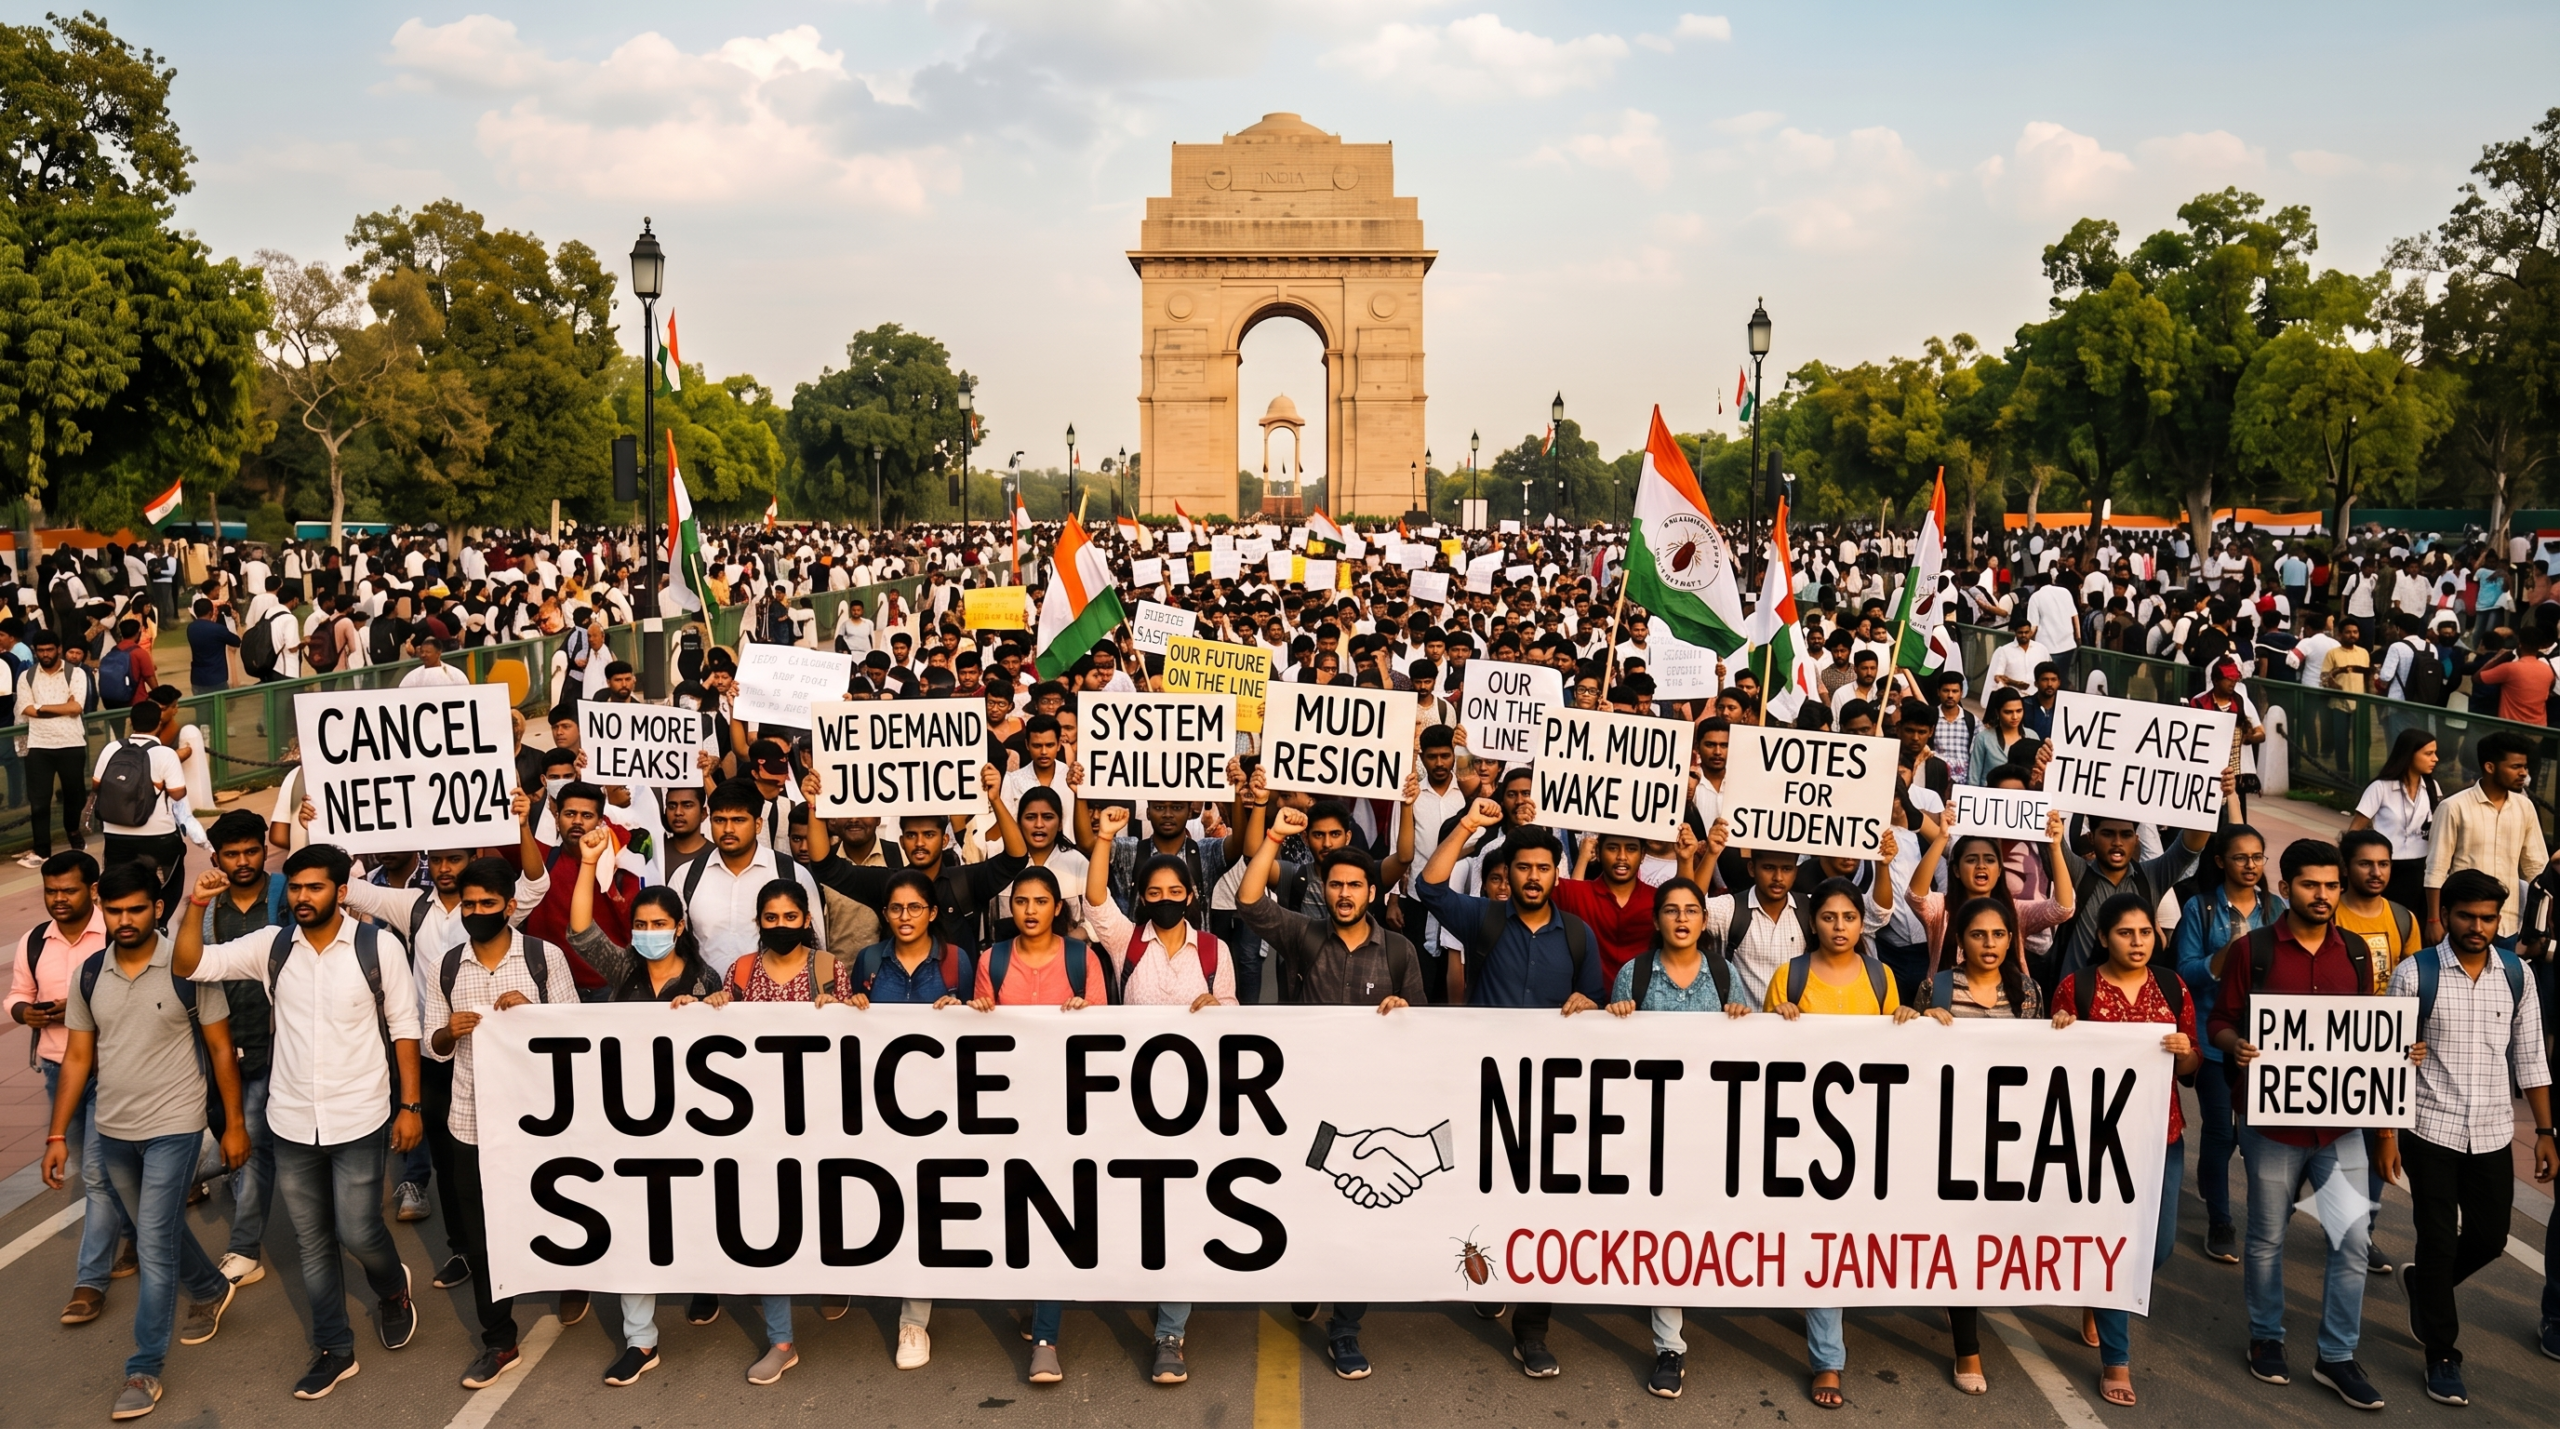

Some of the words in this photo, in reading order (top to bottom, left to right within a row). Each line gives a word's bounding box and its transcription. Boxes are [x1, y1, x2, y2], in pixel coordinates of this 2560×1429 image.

[1256, 172, 1305, 184] INDIA
[1170, 644, 1201, 665] OUR
[1205, 648, 1266, 674] FUTURE
[1168, 667, 1191, 688] ON
[1195, 671, 1226, 693] THE
[1229, 676, 1265, 699] LINE
[1487, 670, 1532, 697] OUR
[317, 699, 498, 765] CANCEL
[588, 710, 622, 740] NO
[630, 714, 697, 745] MORE
[817, 714, 861, 753] WE
[869, 711, 982, 751] DEMAND
[1090, 702, 1224, 743] SYSTEM
[1294, 693, 1386, 740] MUDI
[1467, 697, 1499, 722] ON
[1505, 699, 1546, 726] THE
[1482, 726, 1530, 753] LINE
[1544, 717, 1595, 762] P.M.
[1605, 723, 1681, 778] MUDI,
[1759, 735, 1868, 780] VOTES
[2063, 705, 2122, 751] WE
[2134, 716, 2216, 765] ARE
[596, 746, 688, 781] LEAKS!
[829, 759, 978, 806] JUSTICE
[1090, 750, 1226, 789] FAILURE
[1273, 740, 1401, 790] RESIGN
[2055, 755, 2112, 799] THE
[2119, 764, 2223, 816] FUTURE
[323, 774, 416, 835] NEET
[428, 768, 511, 826] 2024
[1540, 770, 1624, 819] WAKE
[1631, 779, 1679, 827] UP!
[1784, 780, 1833, 808] FOR
[1956, 794, 2051, 832] FUTURE
[1730, 807, 1880, 850] STUDENTS
[2258, 1008, 2315, 1052] P.M.
[2326, 1009, 2412, 1062] MUDI,
[517, 1033, 1020, 1138] JUSTICE
[1065, 1032, 1288, 1137] FOR
[2258, 1064, 2407, 1116] RESIGN!
[1478, 1056, 1685, 1197] NEET
[1709, 1060, 1910, 1201] TEST
[1937, 1063, 2137, 1205] LEAK
[529, 1156, 1288, 1273] STUDENTS
[1505, 1228, 1786, 1288] COCKROACH
[1804, 1232, 1958, 1290] JANTA
[1976, 1234, 2127, 1293] PARTY
